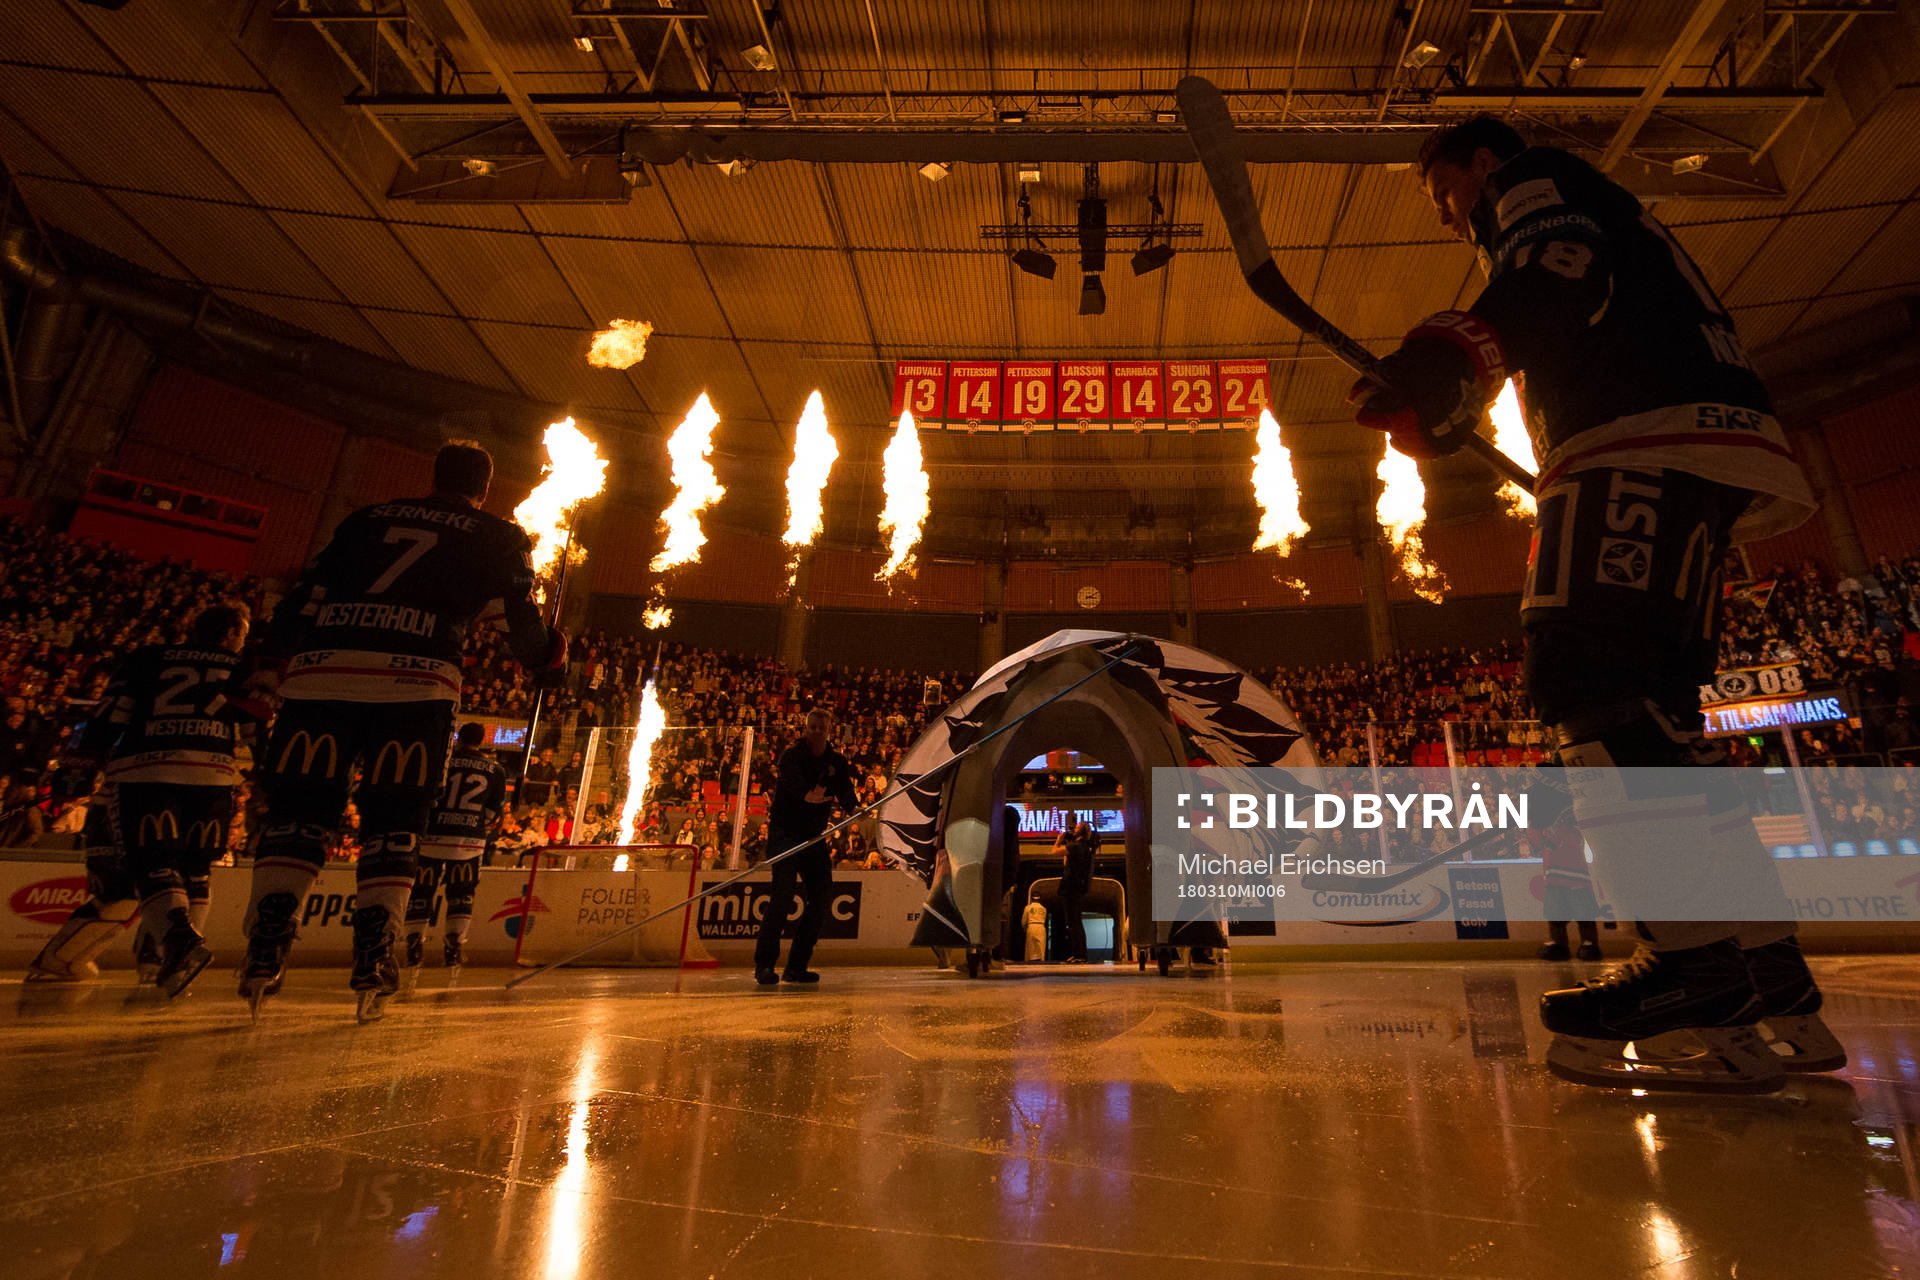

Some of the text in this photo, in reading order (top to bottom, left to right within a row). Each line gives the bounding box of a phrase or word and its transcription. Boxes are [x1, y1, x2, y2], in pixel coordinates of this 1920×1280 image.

[899, 366, 943, 377] LUNDVALL
[953, 367, 998, 377] PETTERSSON
[1007, 367, 1051, 377] PETTERSSON
[1062, 366, 1105, 377] LARSSON
[1170, 365, 1211, 377] SUNDIN
[1221, 365, 1267, 375] ANDERSSON
[902, 379, 937, 412] 13
[958, 380, 992, 414] 14
[1013, 380, 1046, 414] 19
[1062, 379, 1105, 413] 29
[1122, 380, 1155, 413] 14
[1171, 379, 1213, 413] 23
[1224, 378, 1268, 412] 24
[367, 503, 481, 534] SERNEKE
[364, 525, 439, 596] 7
[315, 602, 437, 638] WESTERHOLM
[388, 656, 444, 672] SKF
[152, 665, 232, 717] 27
[1757, 666, 1804, 695] 08
[446, 771, 489, 811] 12
[1312, 887, 1423, 909] Combimix
[1455, 880, 1499, 893] Betong
[1458, 897, 1494, 909] Fasad
[1837, 895, 1909, 918] TYRE
[701, 923, 761, 936] WALLPAP
